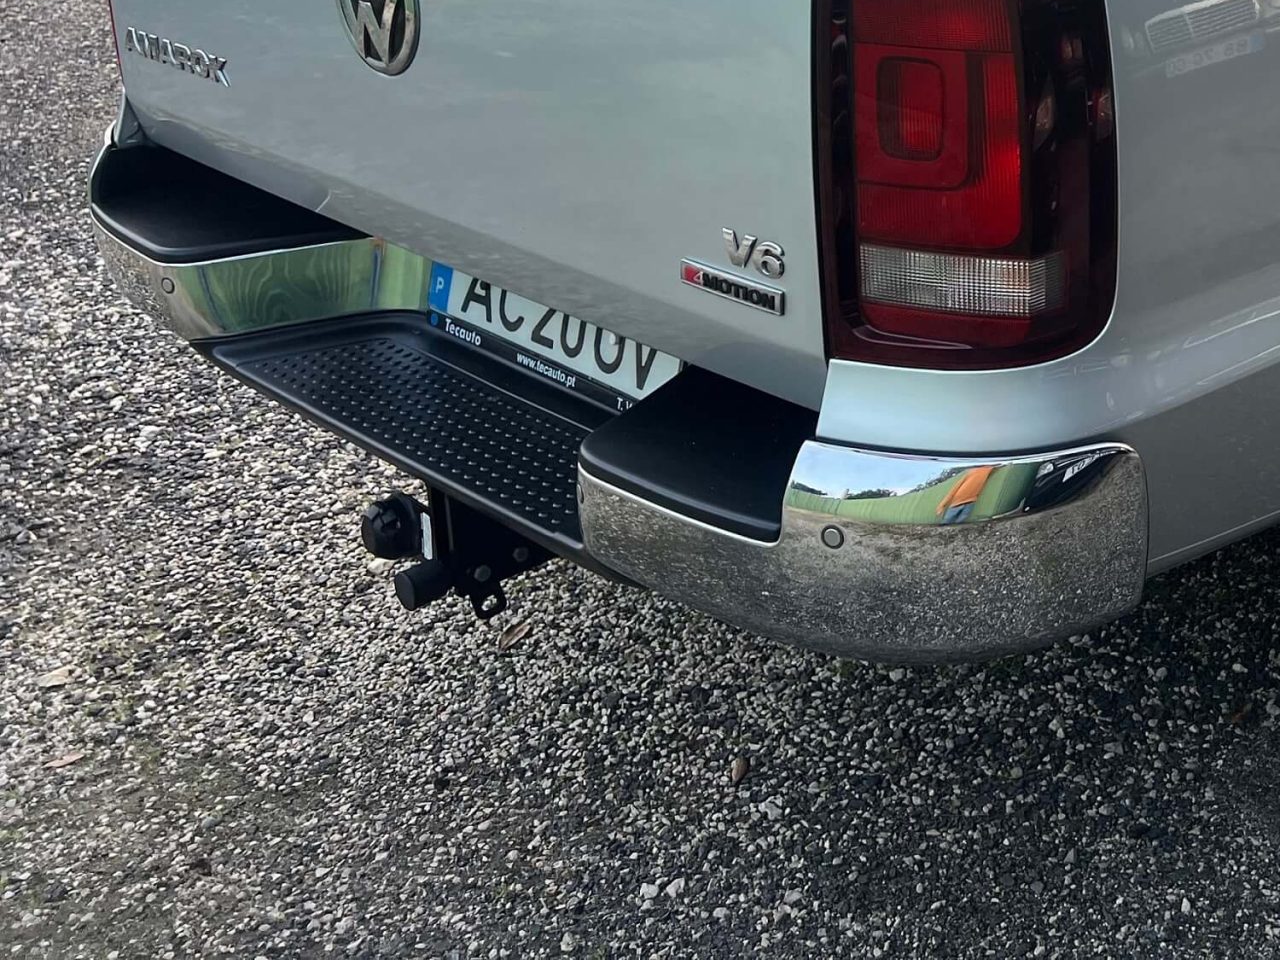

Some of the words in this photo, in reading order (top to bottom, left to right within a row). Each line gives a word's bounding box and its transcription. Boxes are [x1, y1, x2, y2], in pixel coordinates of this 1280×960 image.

[124, 26, 231, 87] AMAROK
[722, 227, 785, 279] V6
[435, 276, 444, 293] P
[692, 270, 776, 311] 4MOTION
[444, 317, 482, 346] Tecauto
[516, 351, 576, 388] www.tecauto.pt
